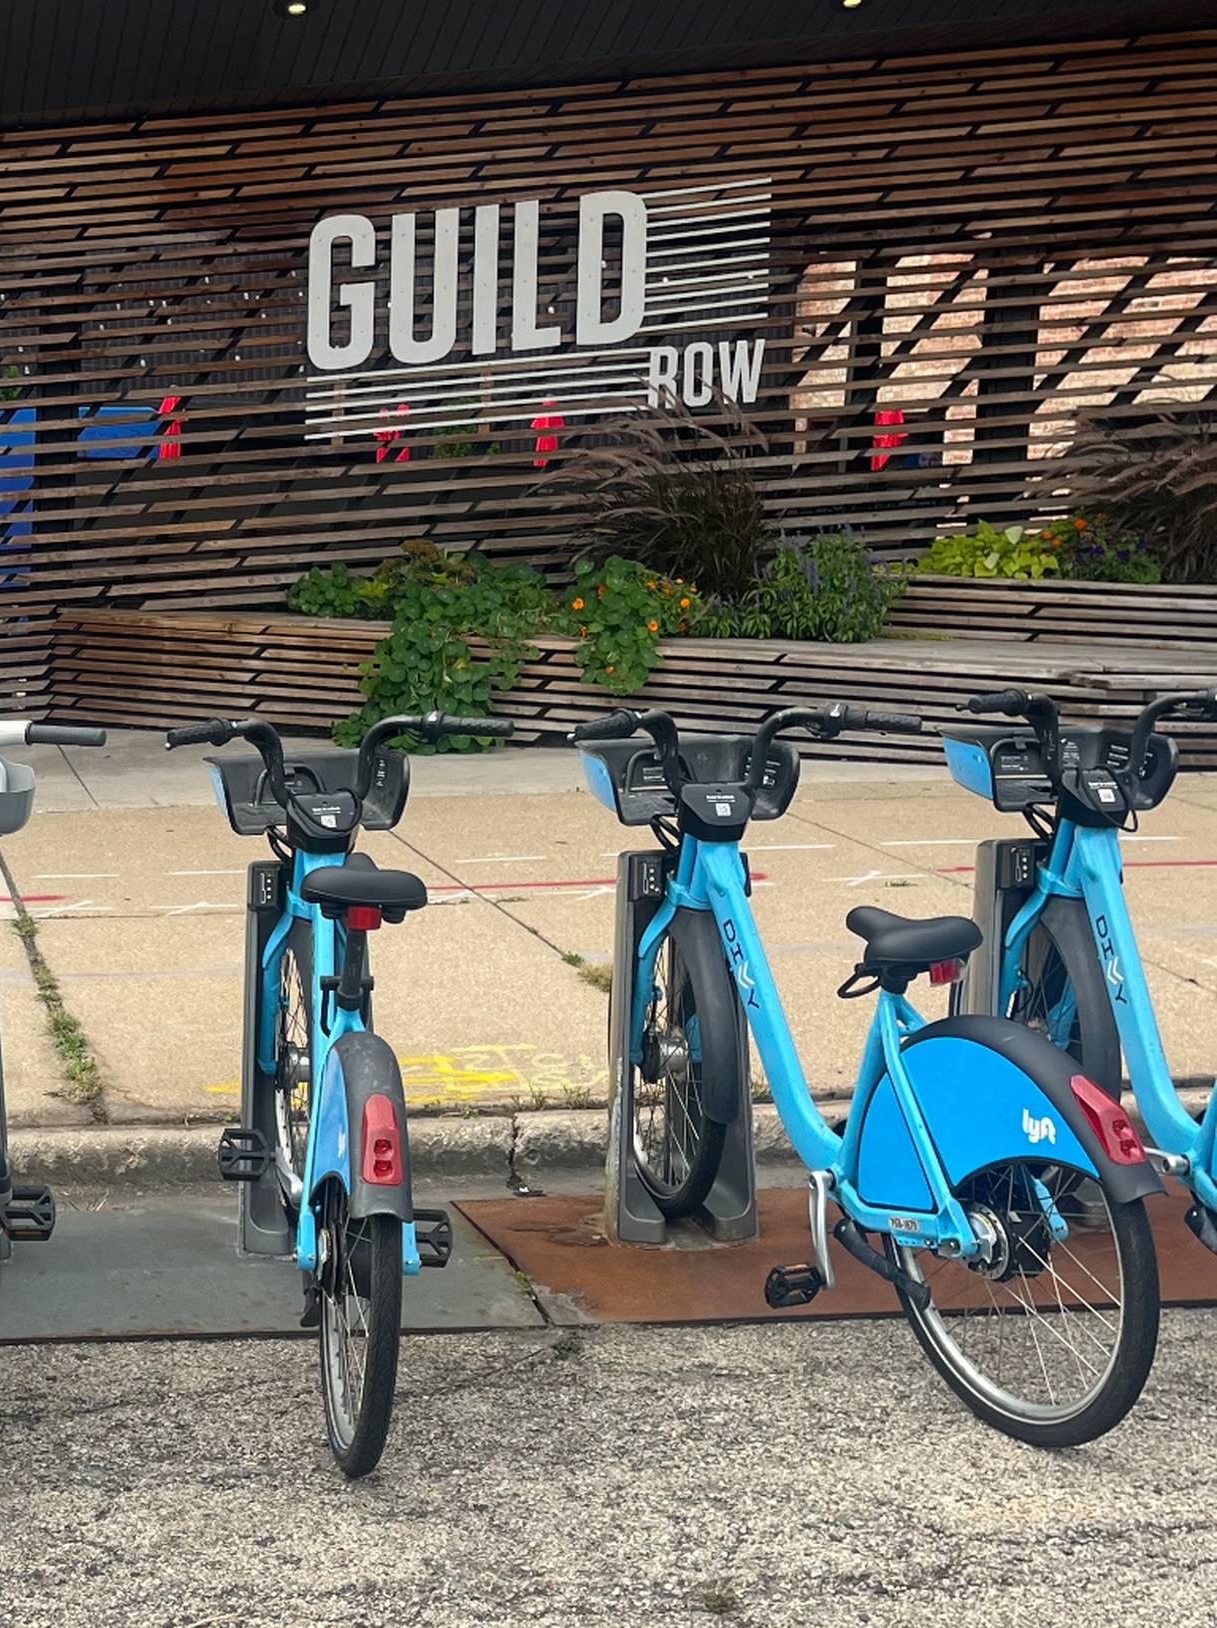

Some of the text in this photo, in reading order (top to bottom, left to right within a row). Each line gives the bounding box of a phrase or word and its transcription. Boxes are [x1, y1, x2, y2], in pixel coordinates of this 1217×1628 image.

[307, 190, 648, 370] GUILD
[647, 338, 766, 410] ROW
[1022, 1109, 1057, 1145] lyft
